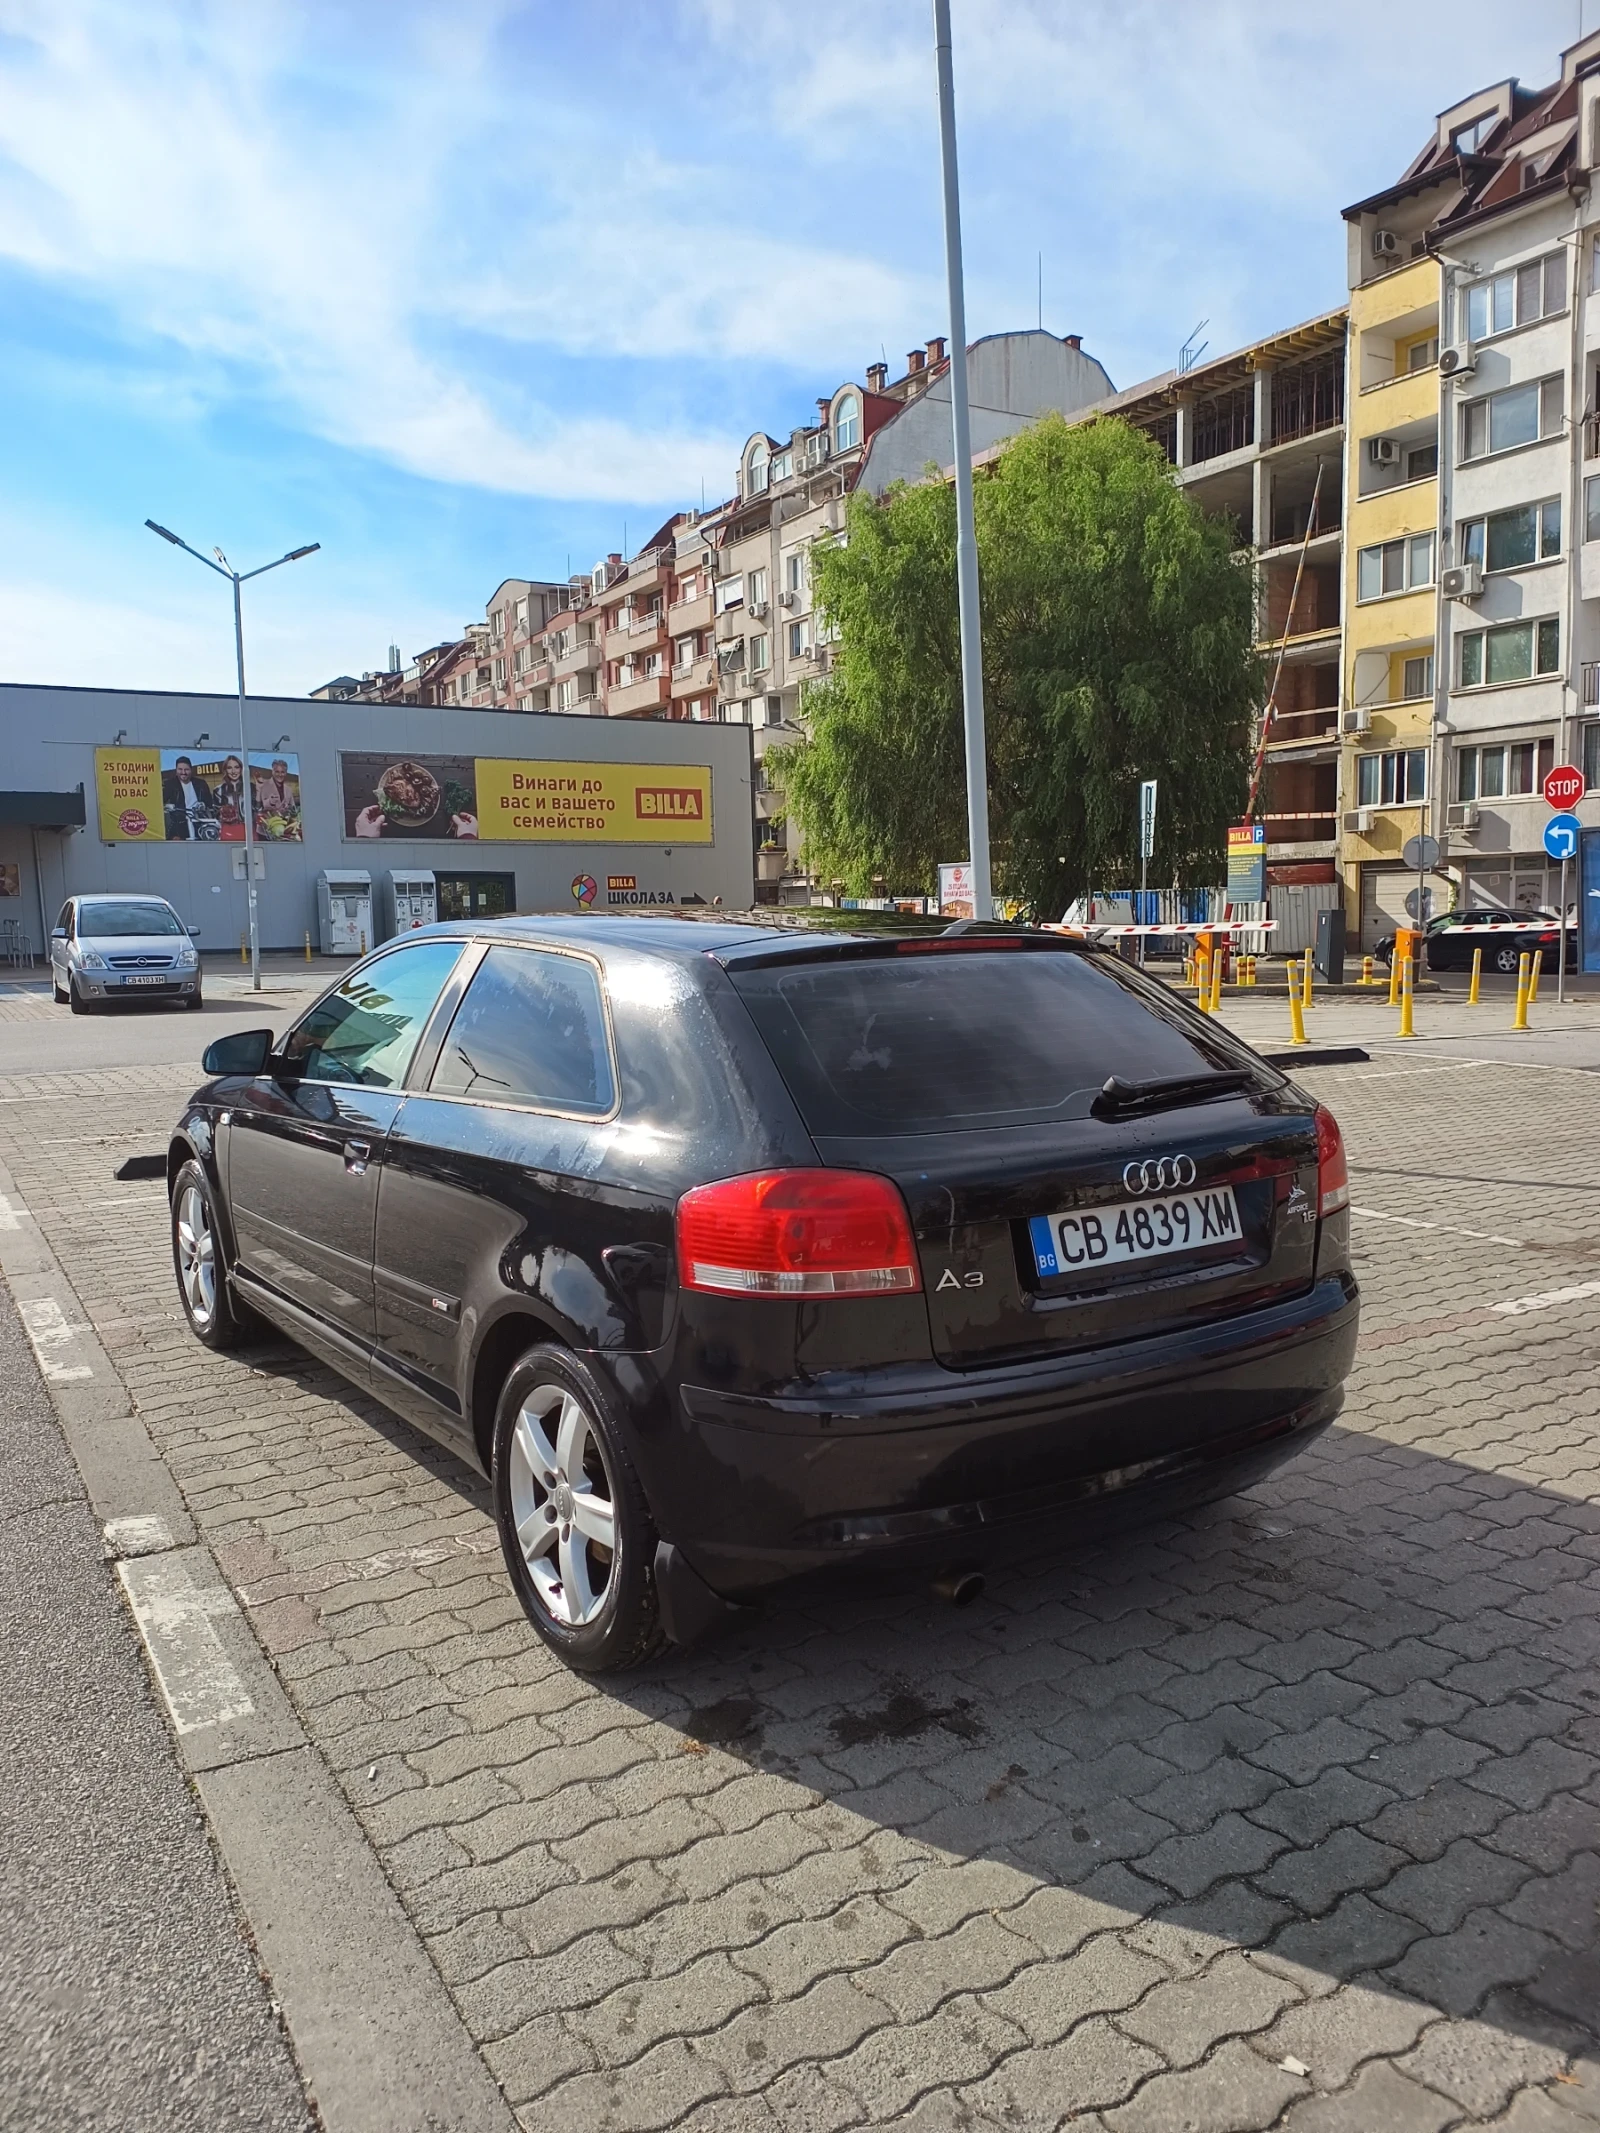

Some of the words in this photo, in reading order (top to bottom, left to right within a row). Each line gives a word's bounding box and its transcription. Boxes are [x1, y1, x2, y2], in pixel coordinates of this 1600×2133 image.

[103, 763, 115, 771] 25
[116, 763, 155, 773] ГОДИНИ
[111, 775, 149, 785] ВИНАГИ
[512, 773, 577, 792] Винаги
[581, 779, 603, 794] до
[1548, 779, 1580, 797] STOP
[113, 788, 128, 799] ДО
[129, 788, 149, 798] ВАС
[500, 796, 531, 809] вас
[535, 797, 546, 809] и
[552, 797, 616, 811] вашето
[640, 793, 699, 815] BILLA
[512, 813, 605, 829] семейство
[1229, 831, 1252, 842] BILLA
[609, 878, 635, 888] BILLA
[1058, 1215, 1108, 1264] CB
[1115, 1200, 1190, 1253] 4839
[1193, 1192, 1237, 1240] XM
[1038, 1253, 1056, 1269] BG
[935, 1268, 984, 1292] A3
